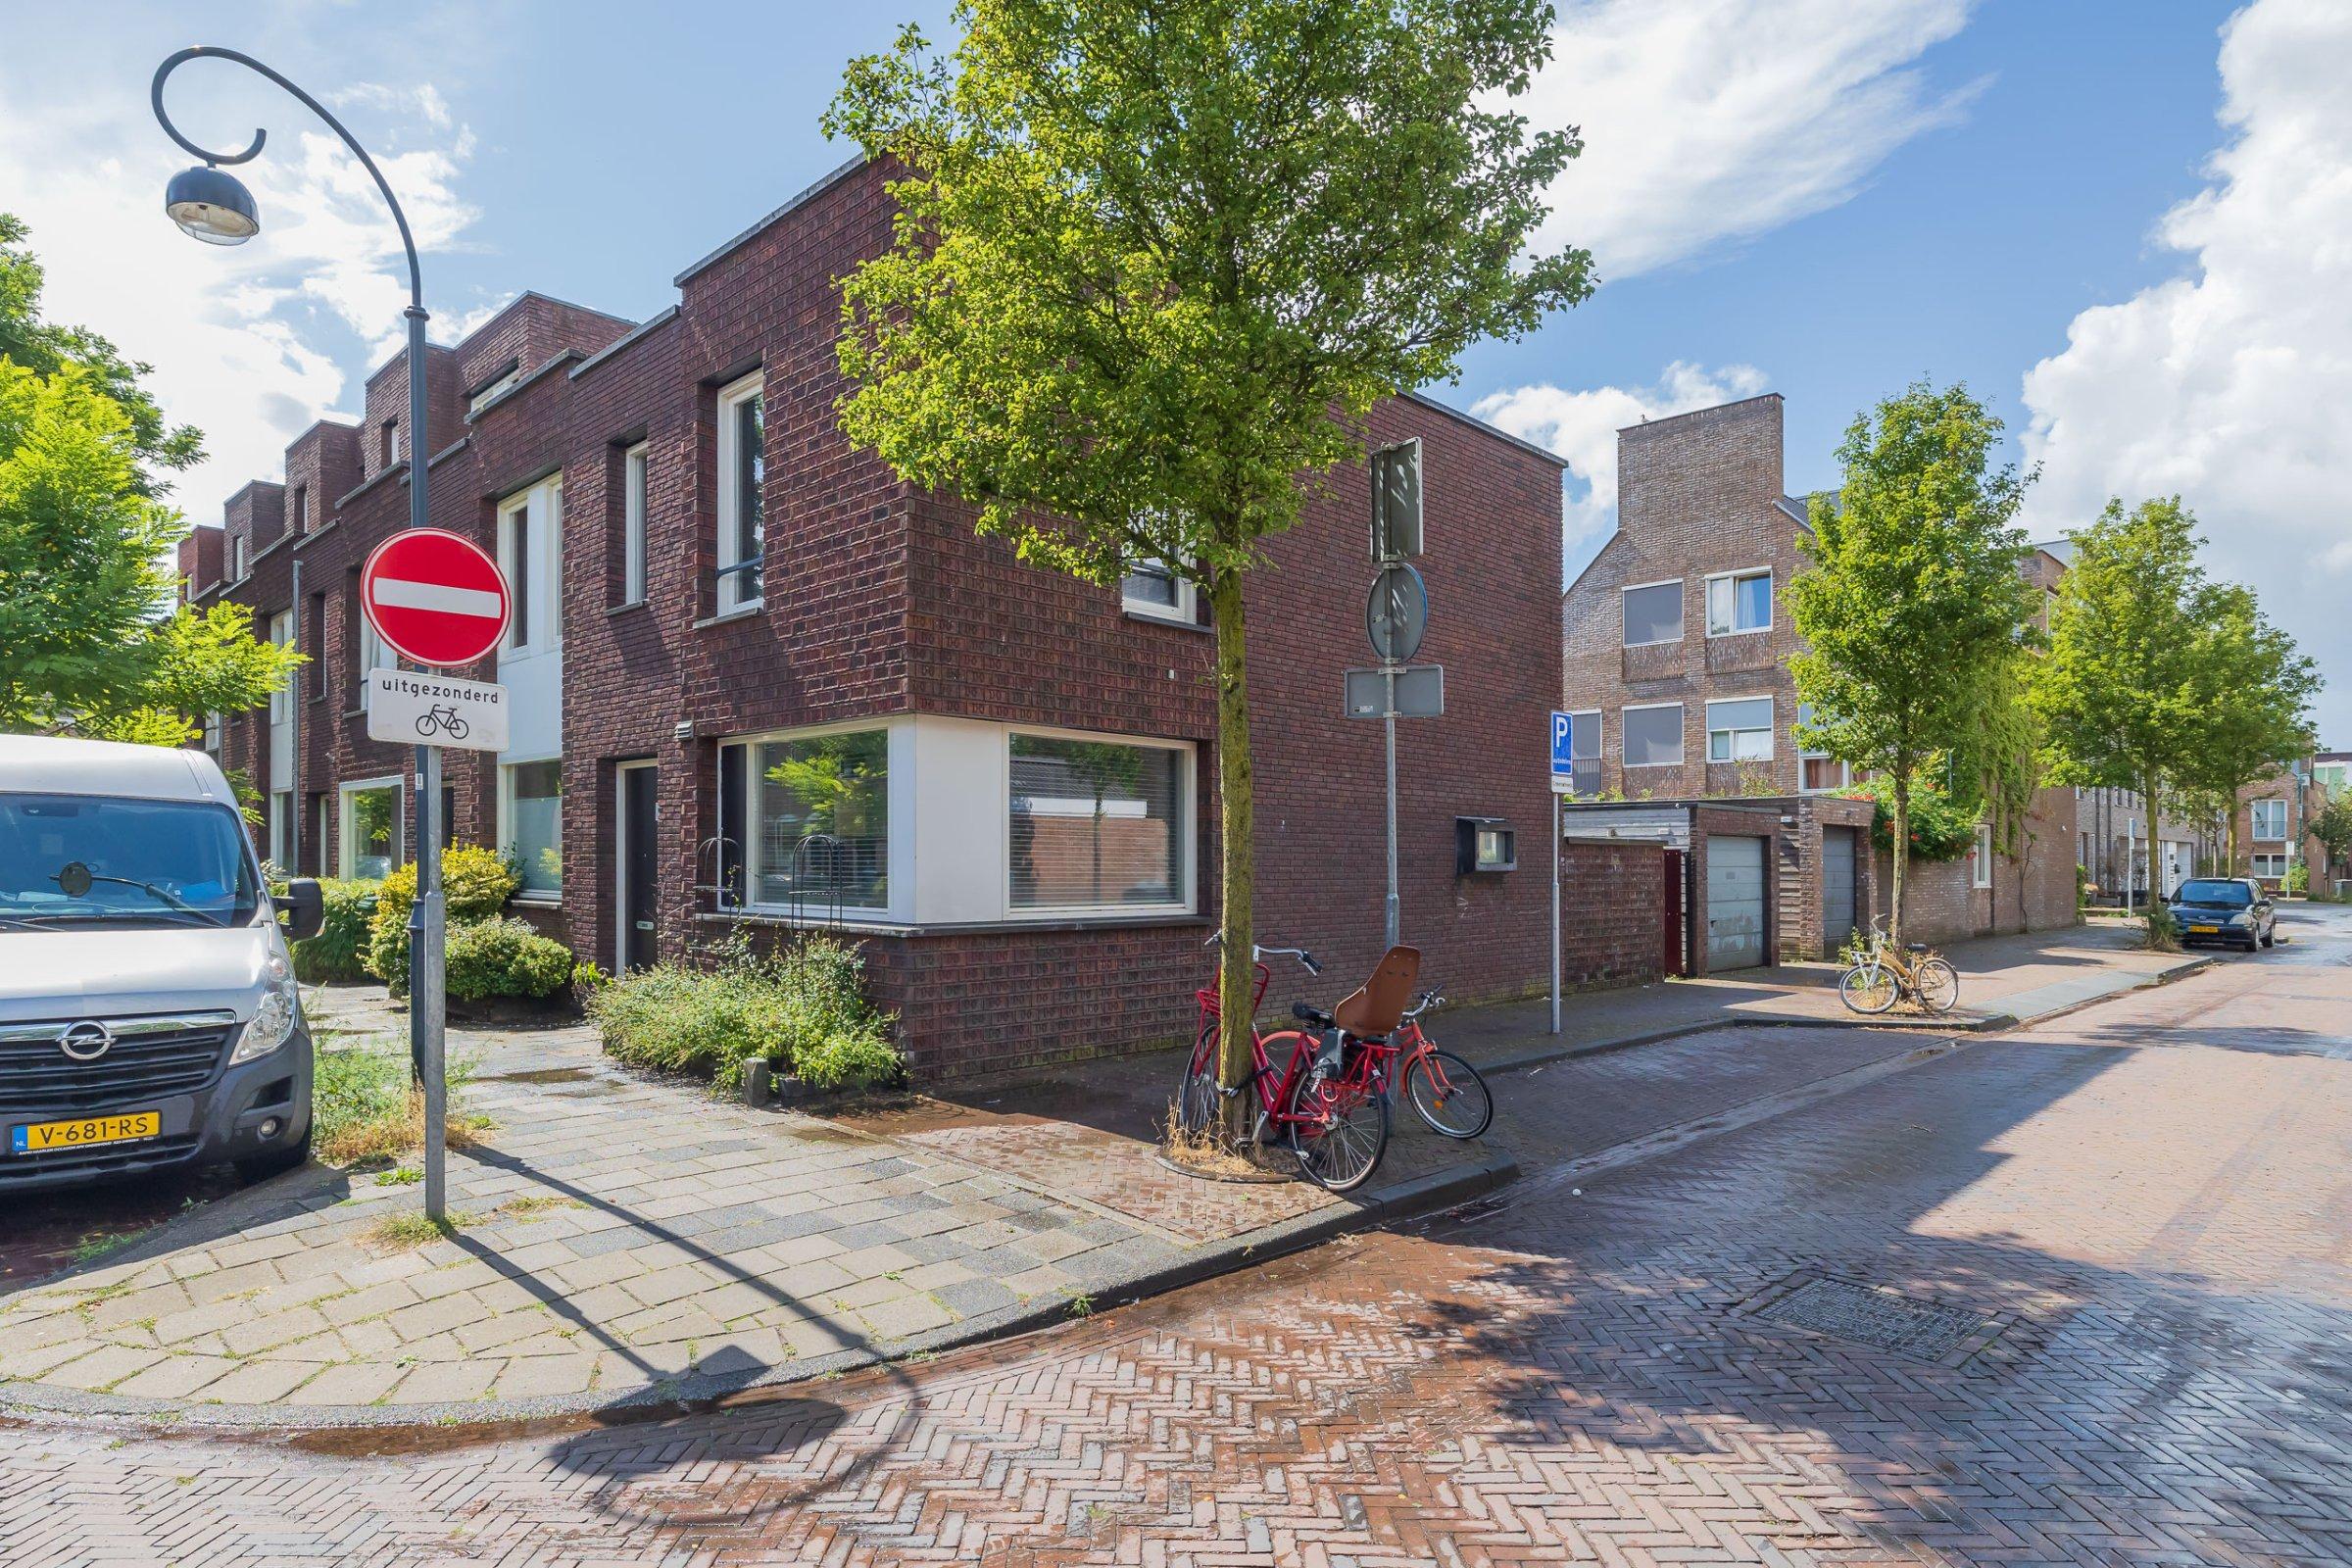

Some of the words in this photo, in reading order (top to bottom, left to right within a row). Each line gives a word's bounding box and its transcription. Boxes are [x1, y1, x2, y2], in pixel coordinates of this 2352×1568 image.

[382, 678, 499, 704] uitgezonderd
[1555, 716, 1568, 748] P
[39, 1116, 148, 1145] V-681-RS
